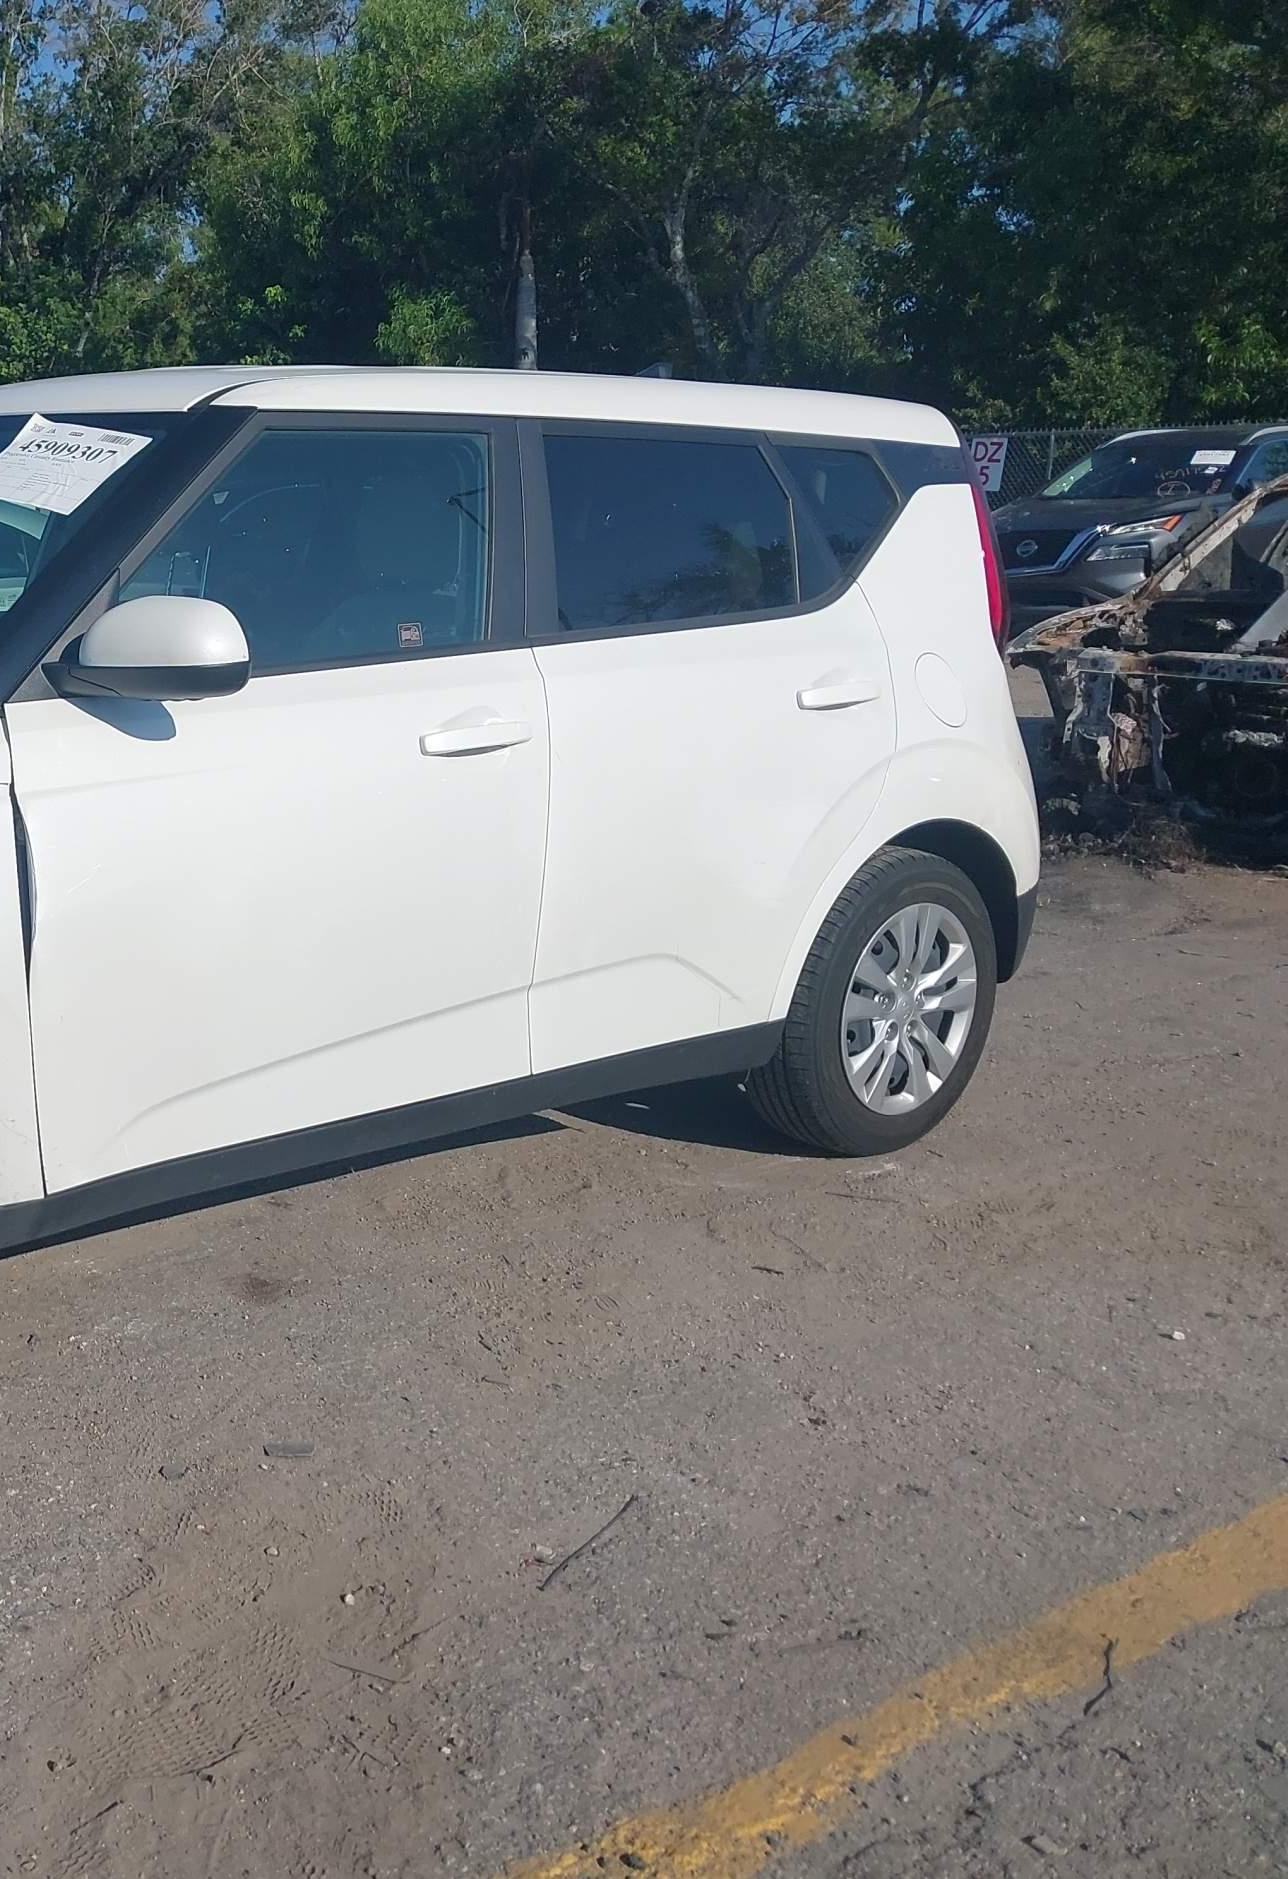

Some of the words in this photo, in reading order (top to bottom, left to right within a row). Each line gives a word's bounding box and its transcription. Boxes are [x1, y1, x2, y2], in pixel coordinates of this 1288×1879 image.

[18, 438, 119, 464] 45909307
[973, 441, 1004, 464] DZ
[979, 465, 990, 486] 5
